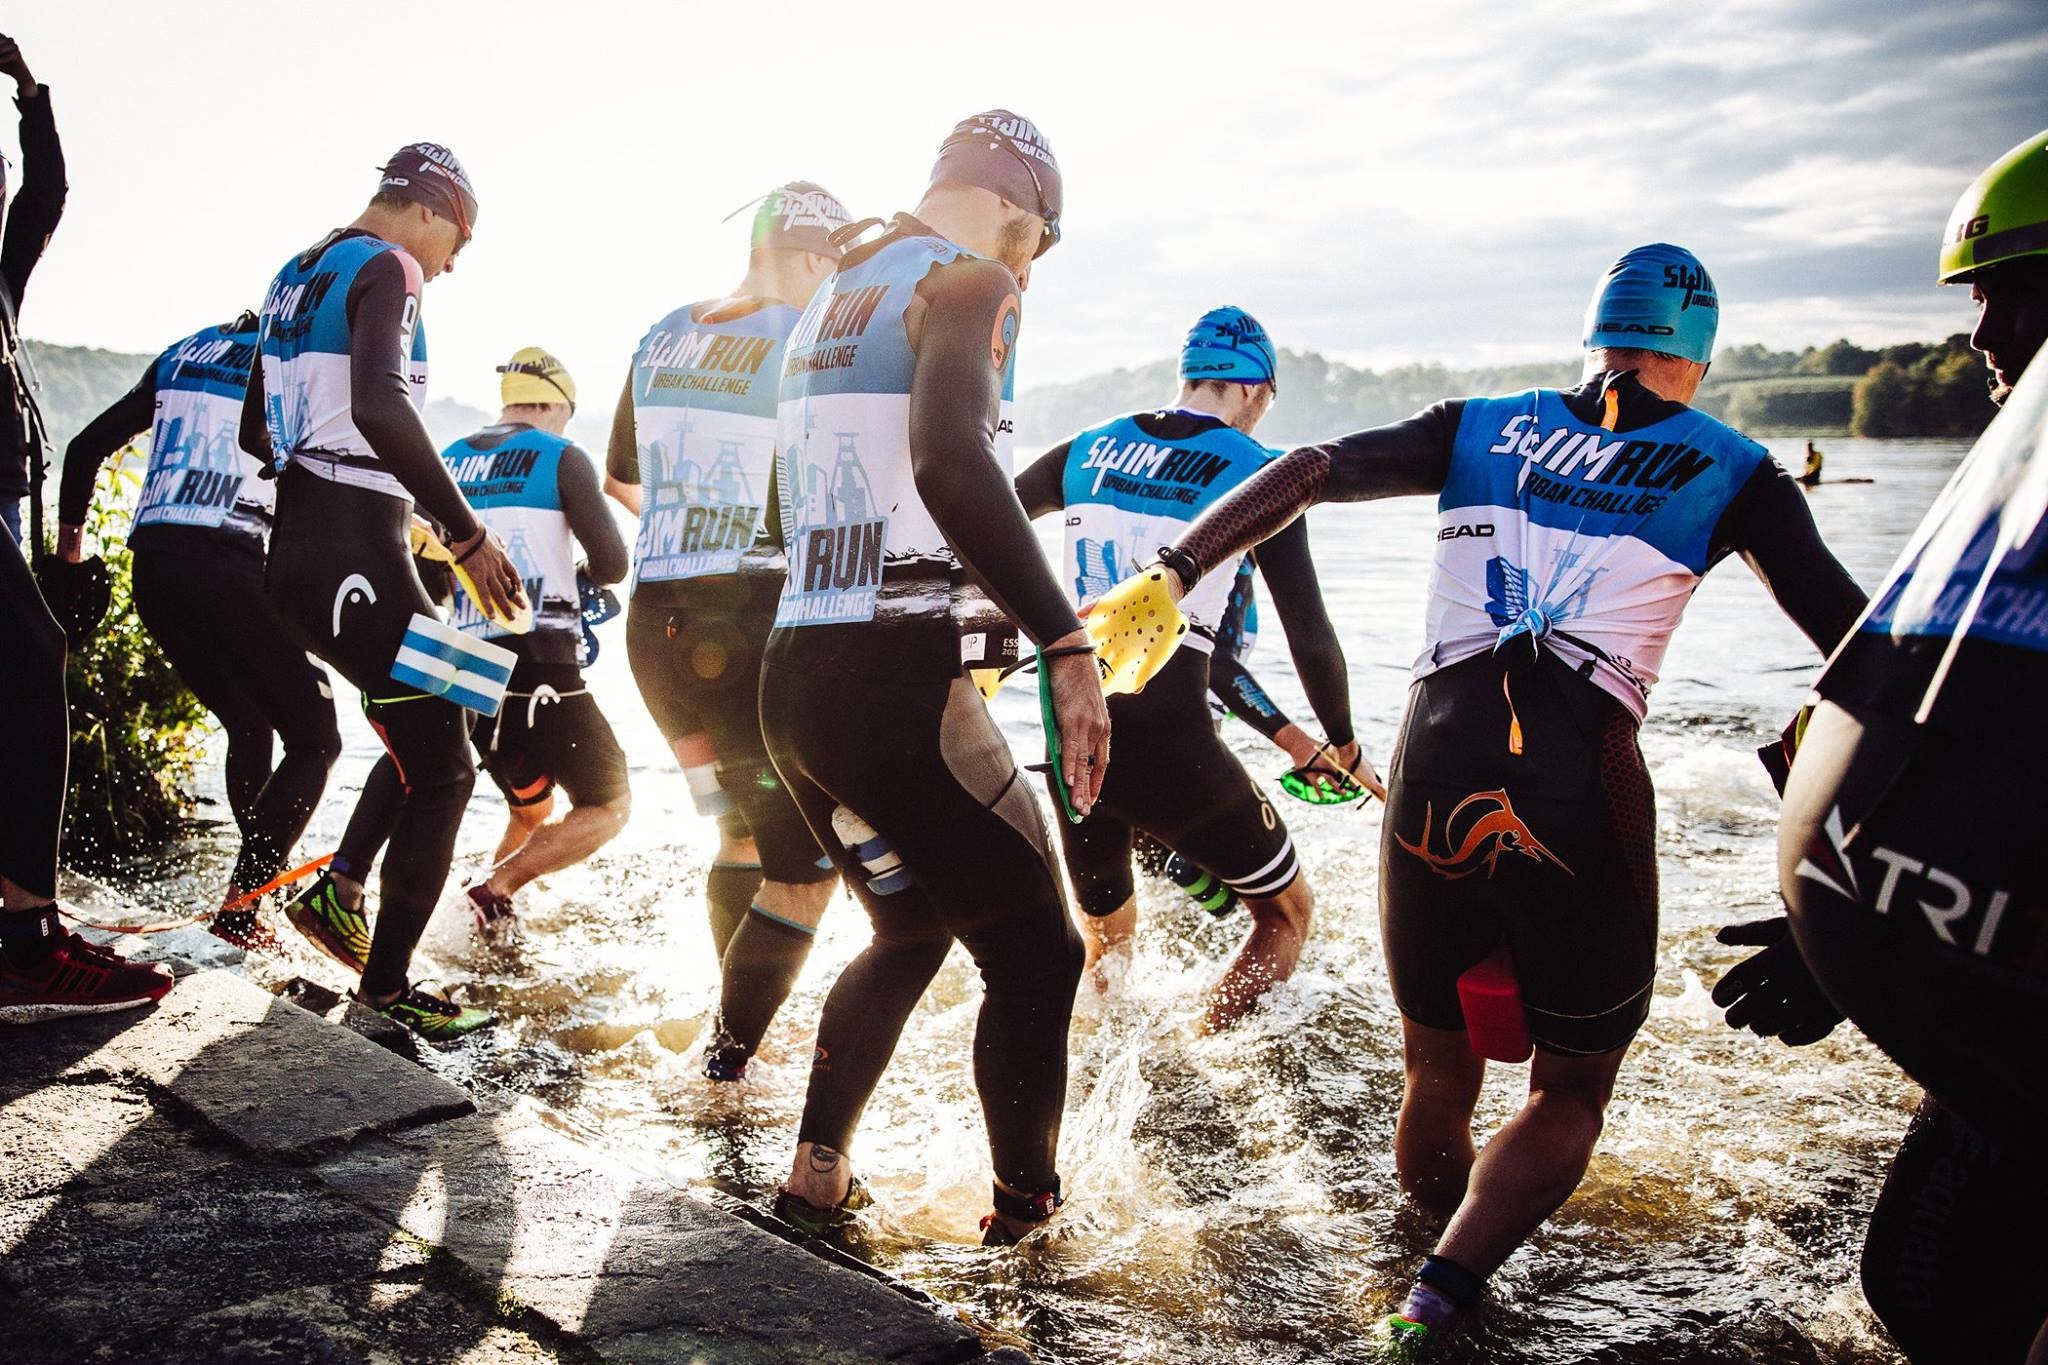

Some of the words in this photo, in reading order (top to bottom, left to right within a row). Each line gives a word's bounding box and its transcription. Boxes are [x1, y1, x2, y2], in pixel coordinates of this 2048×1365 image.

[380, 176, 410, 187] AD
[640, 329, 777, 398] SWIMRUN
[808, 344, 859, 372] ALLENGE
[1183, 362, 1235, 373] EAD
[682, 375, 752, 396] CHALLENGE
[1080, 436, 1232, 497] SWIMRUN
[1102, 473, 1139, 497] URBAN
[1138, 481, 1201, 505] CHALLENGE
[1528, 470, 1573, 505] RBAN
[1437, 523, 1496, 542] EAD
[798, 592, 874, 621] HALLENGE
